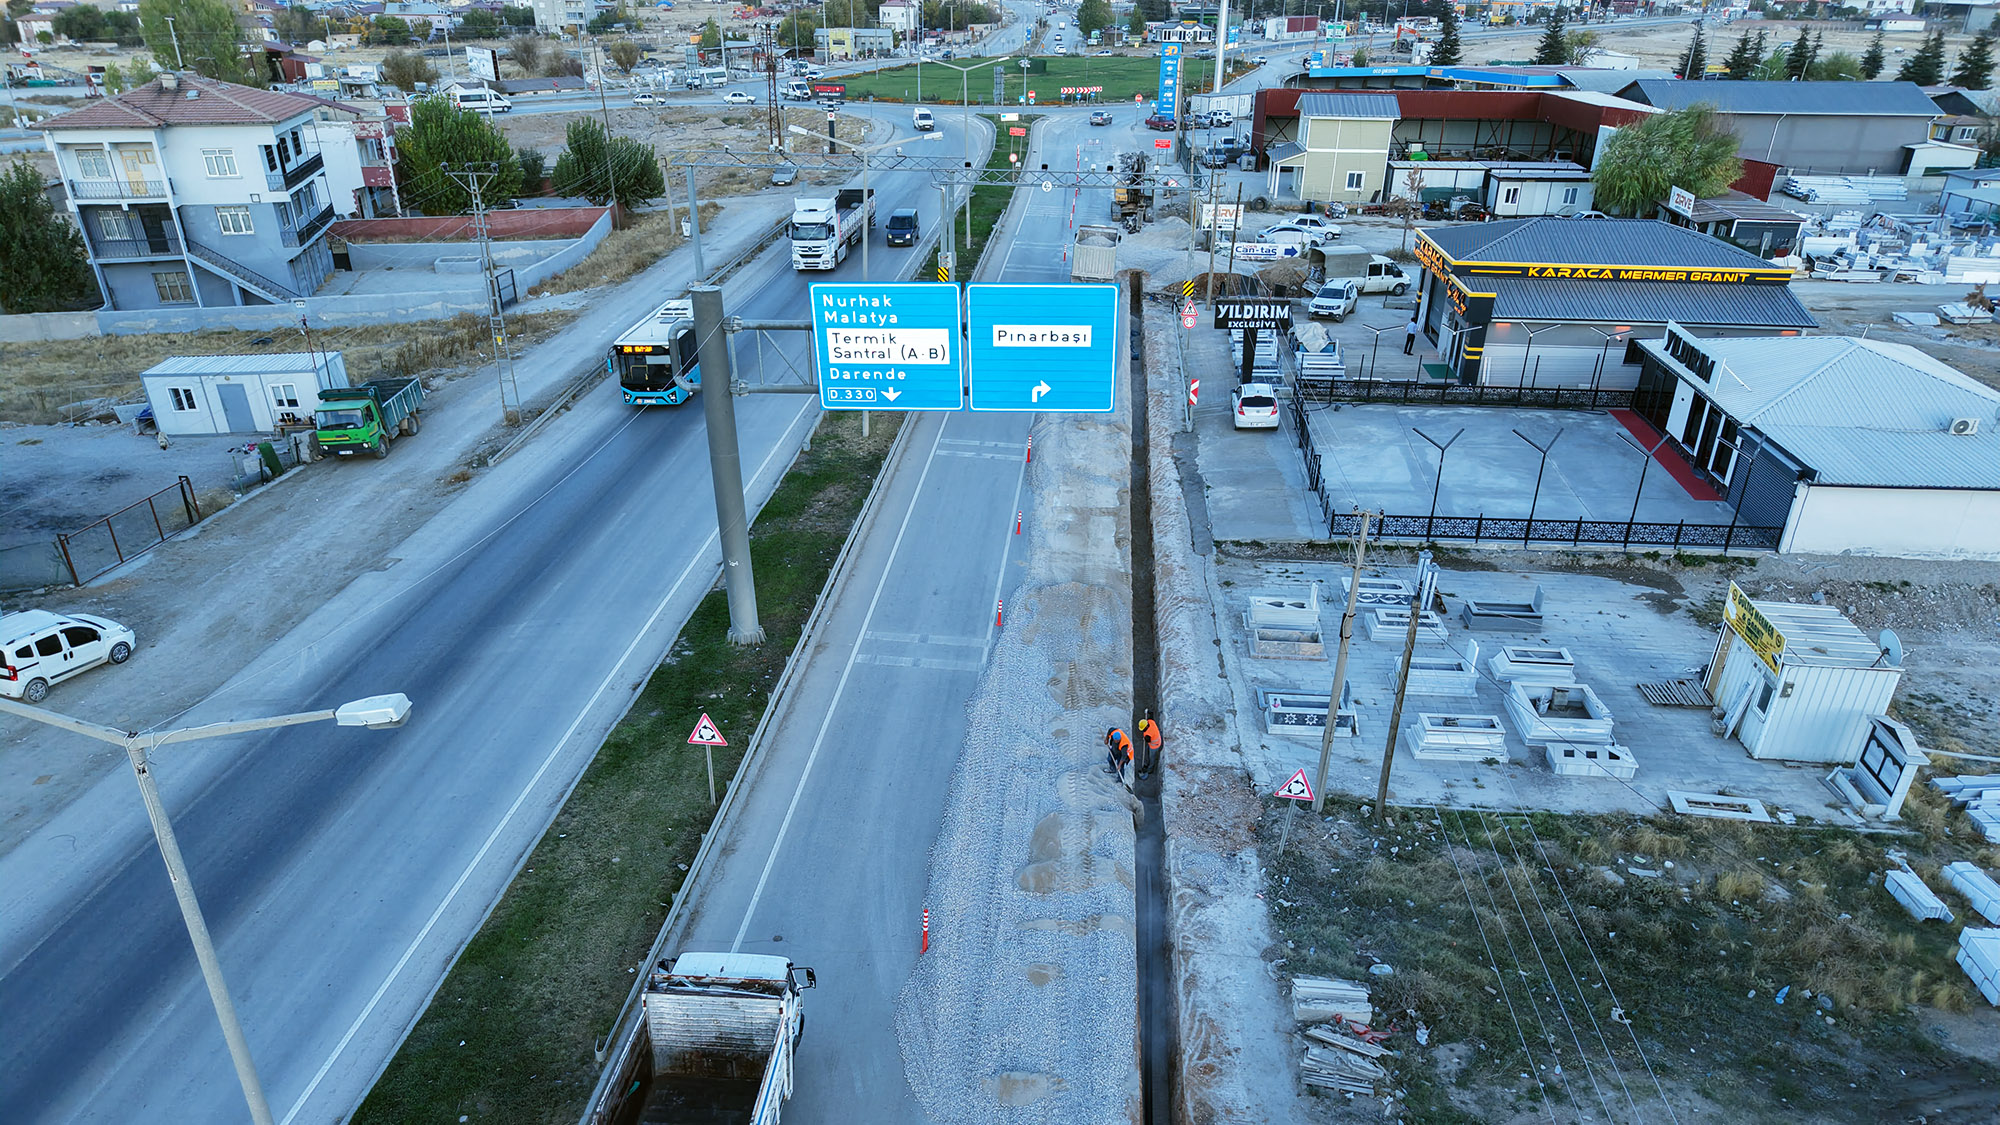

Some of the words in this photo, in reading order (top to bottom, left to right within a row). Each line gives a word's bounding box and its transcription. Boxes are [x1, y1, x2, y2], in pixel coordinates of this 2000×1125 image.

[1528, 267, 1613, 279] KARACA
[1619, 270, 1687, 281] MERMER
[1690, 271, 1750, 283] GRANİT
[823, 294, 892, 307] Nurhak
[1217, 304, 1290, 319] YILDIRIM
[824, 311, 898, 326] Malatya
[832, 332, 897, 344] Termik
[998, 330, 1087, 344] Pınarbaşı
[834, 347, 891, 359] Santral
[830, 368, 906, 380] Darende
[830, 389, 874, 400] D.330
